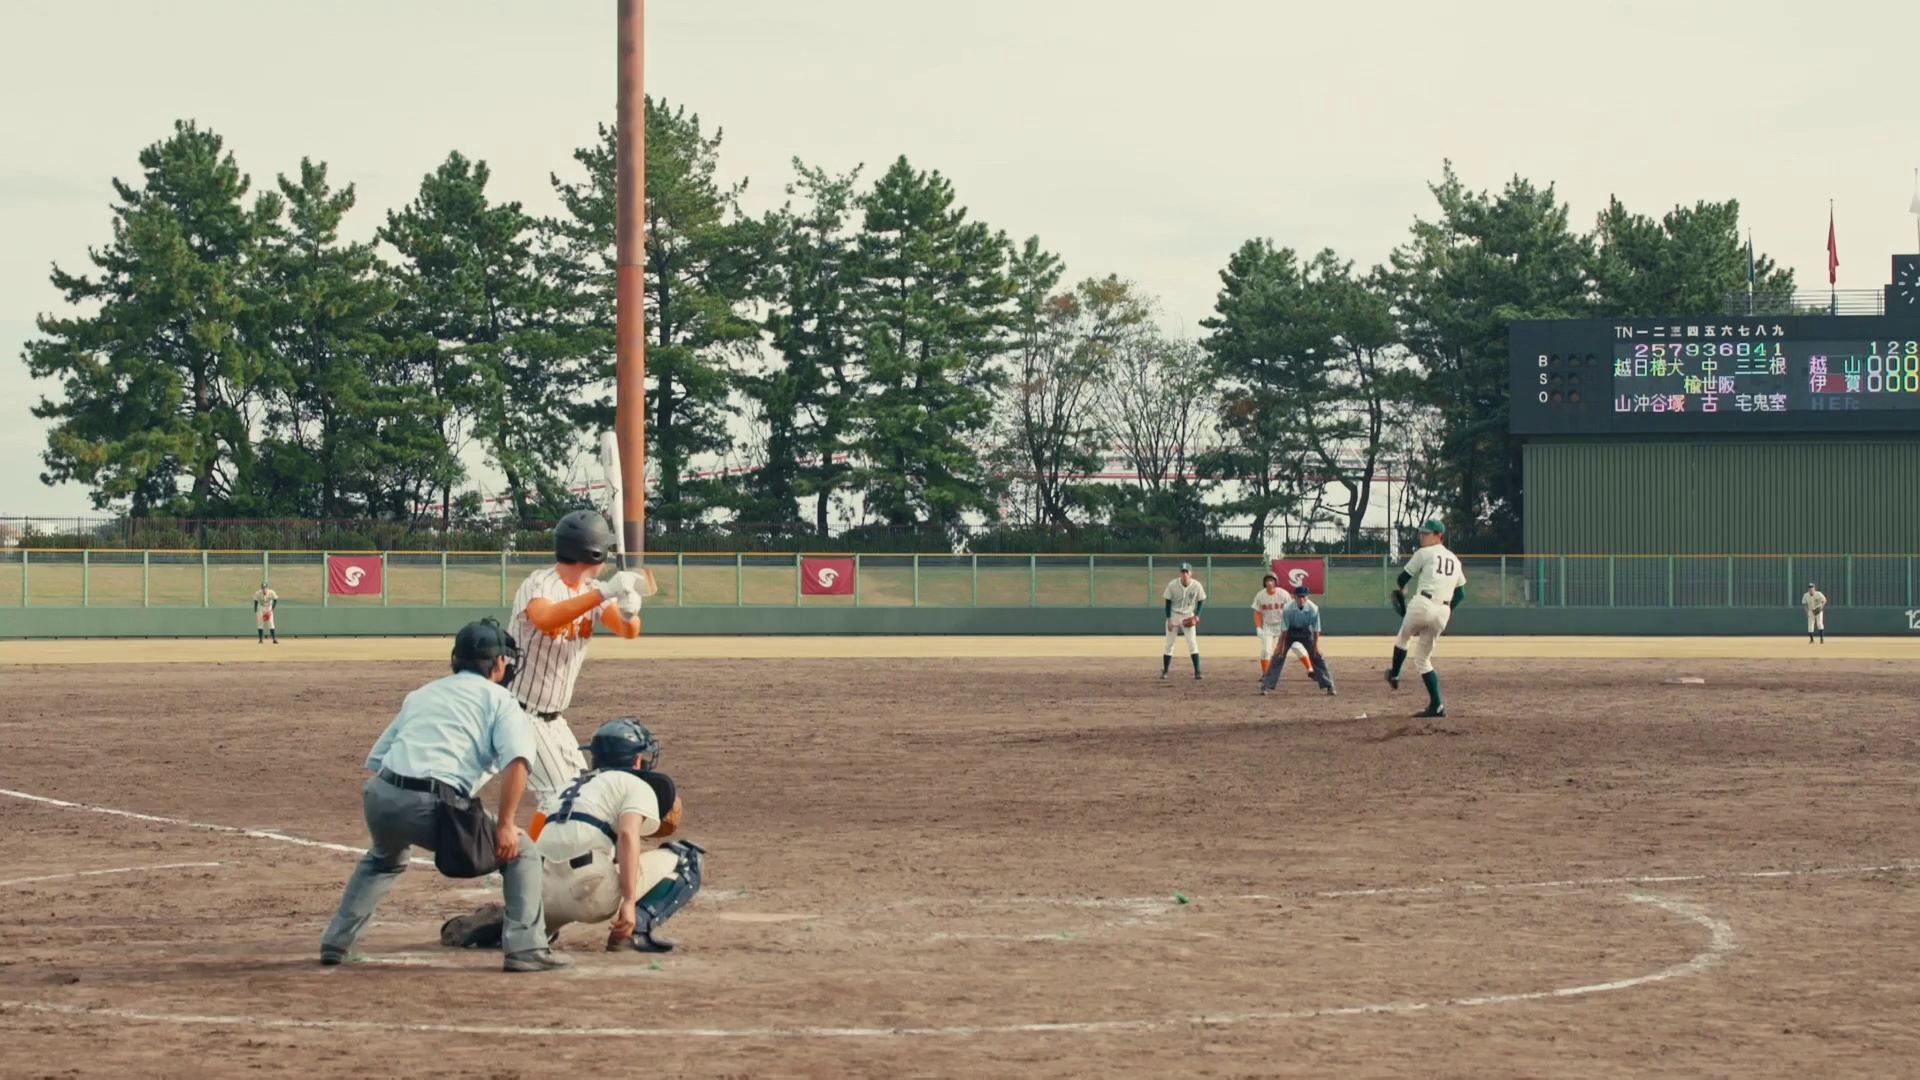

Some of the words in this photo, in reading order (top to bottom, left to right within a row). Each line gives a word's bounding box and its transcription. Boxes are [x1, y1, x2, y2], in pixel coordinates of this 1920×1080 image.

[1614, 326, 1633, 338] TN
[1869, 341, 1878, 355] 1
[1887, 341, 1900, 355] 2
[1904, 341, 1919, 355] 3
[1538, 355, 1548, 368] B
[1539, 373, 1548, 385] S
[1436, 555, 1454, 576] 10
